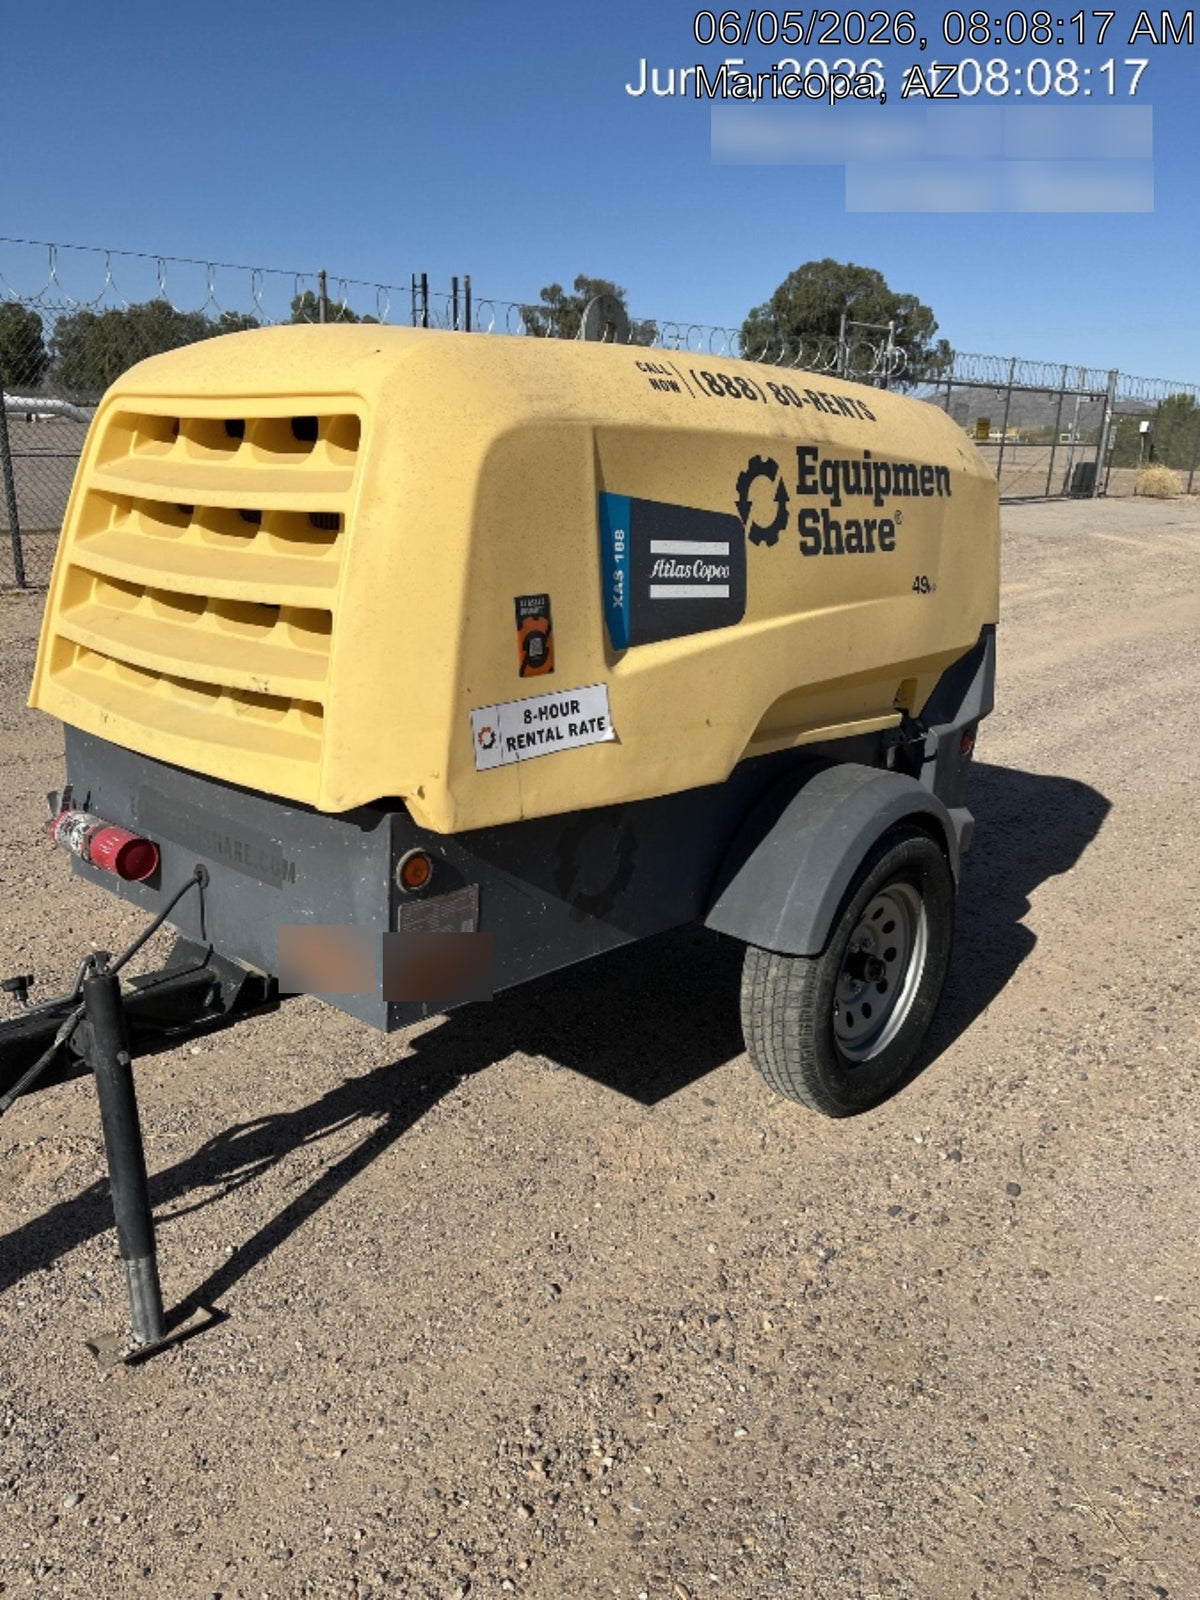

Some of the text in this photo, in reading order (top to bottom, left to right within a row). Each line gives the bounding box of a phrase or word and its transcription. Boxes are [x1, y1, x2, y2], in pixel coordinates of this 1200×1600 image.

[635, 360, 673, 376] CALL
[648, 377, 682, 394] NOW
[688, 368, 877, 422] (888) 80-RENTS
[795, 445, 952, 508] Equipmen
[612, 528, 626, 609] XAS 188
[523, 699, 581, 725] 8-HOUR
[505, 716, 606, 753] RENTAL RATE
